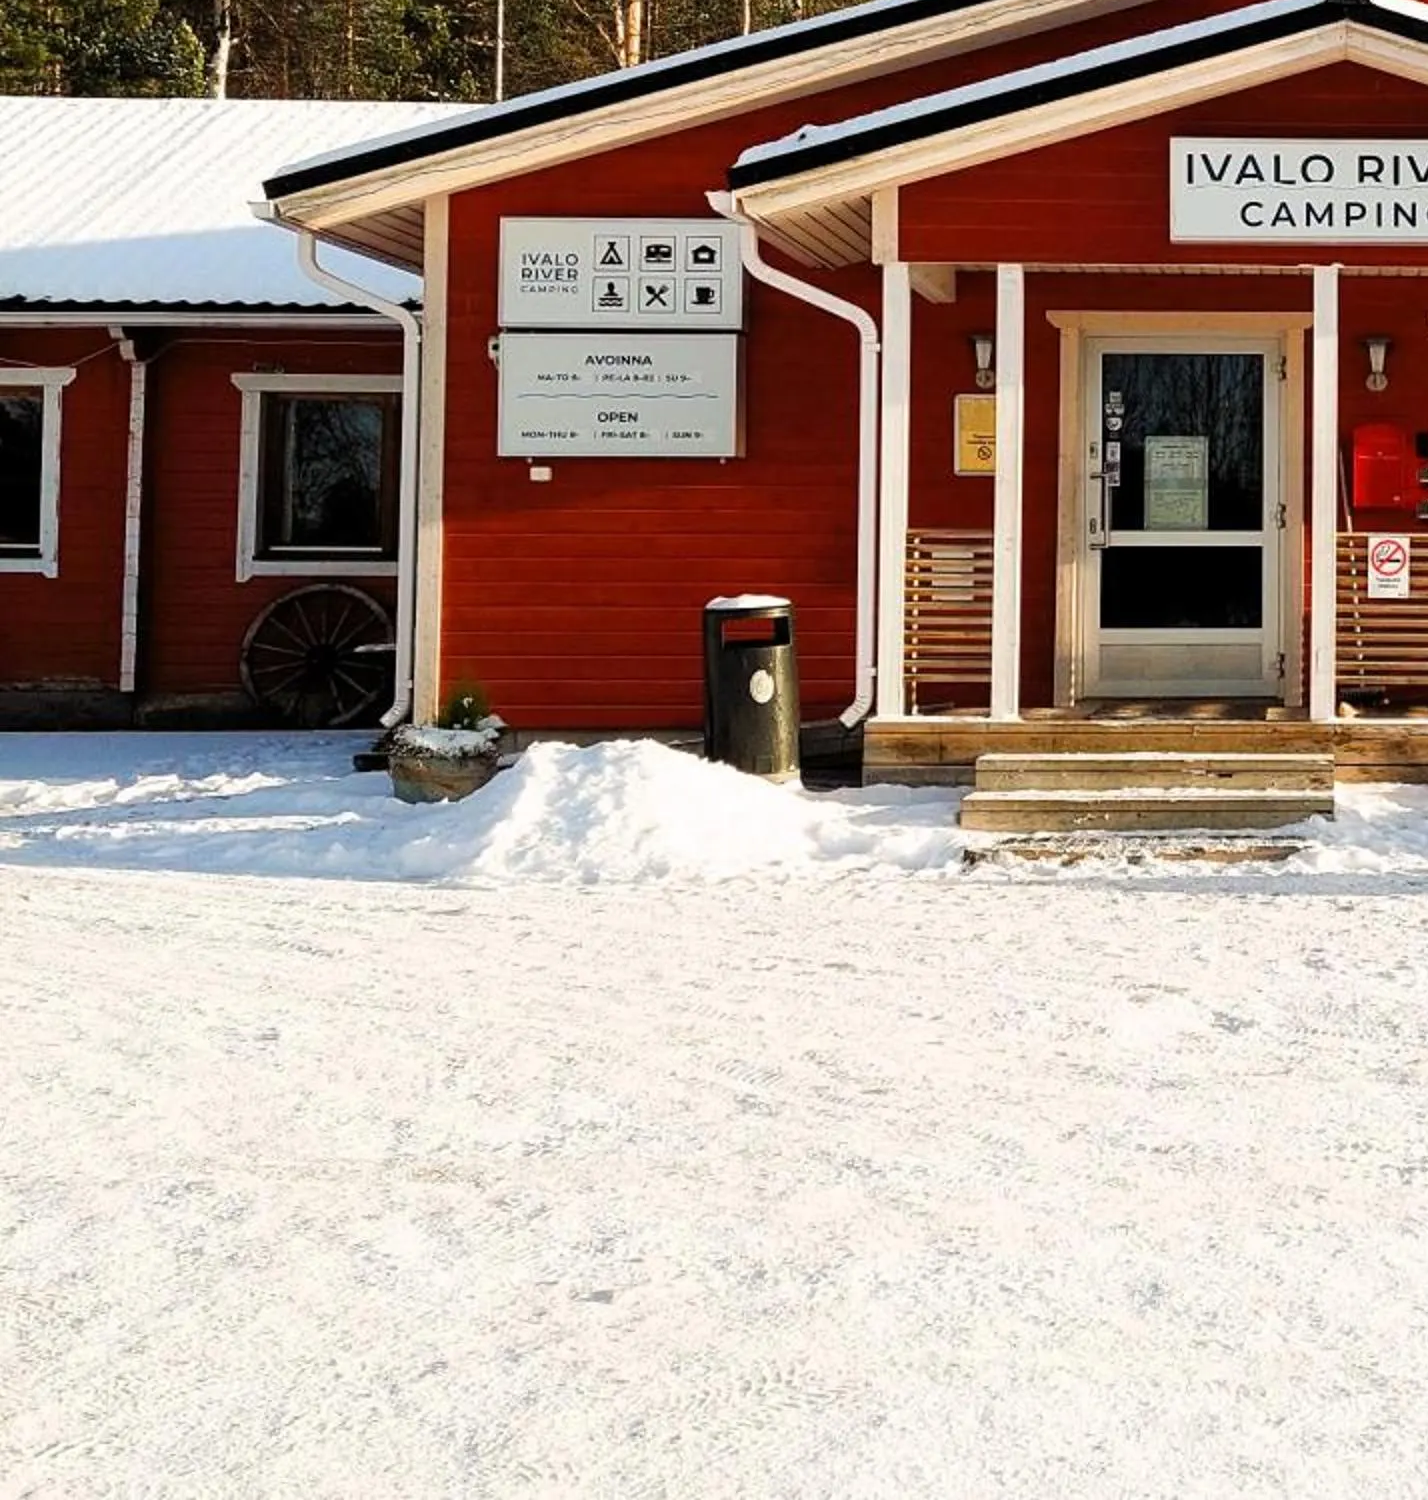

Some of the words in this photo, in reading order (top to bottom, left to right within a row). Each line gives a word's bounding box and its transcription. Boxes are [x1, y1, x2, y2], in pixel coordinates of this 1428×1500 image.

[1186, 153, 1336, 185] IVALO
[521, 252, 579, 266] IVALO
[521, 267, 579, 281] RIVER
[520, 285, 579, 294] CAMPING
[585, 355, 653, 366] AVOINNA
[597, 411, 639, 423] OPEN
